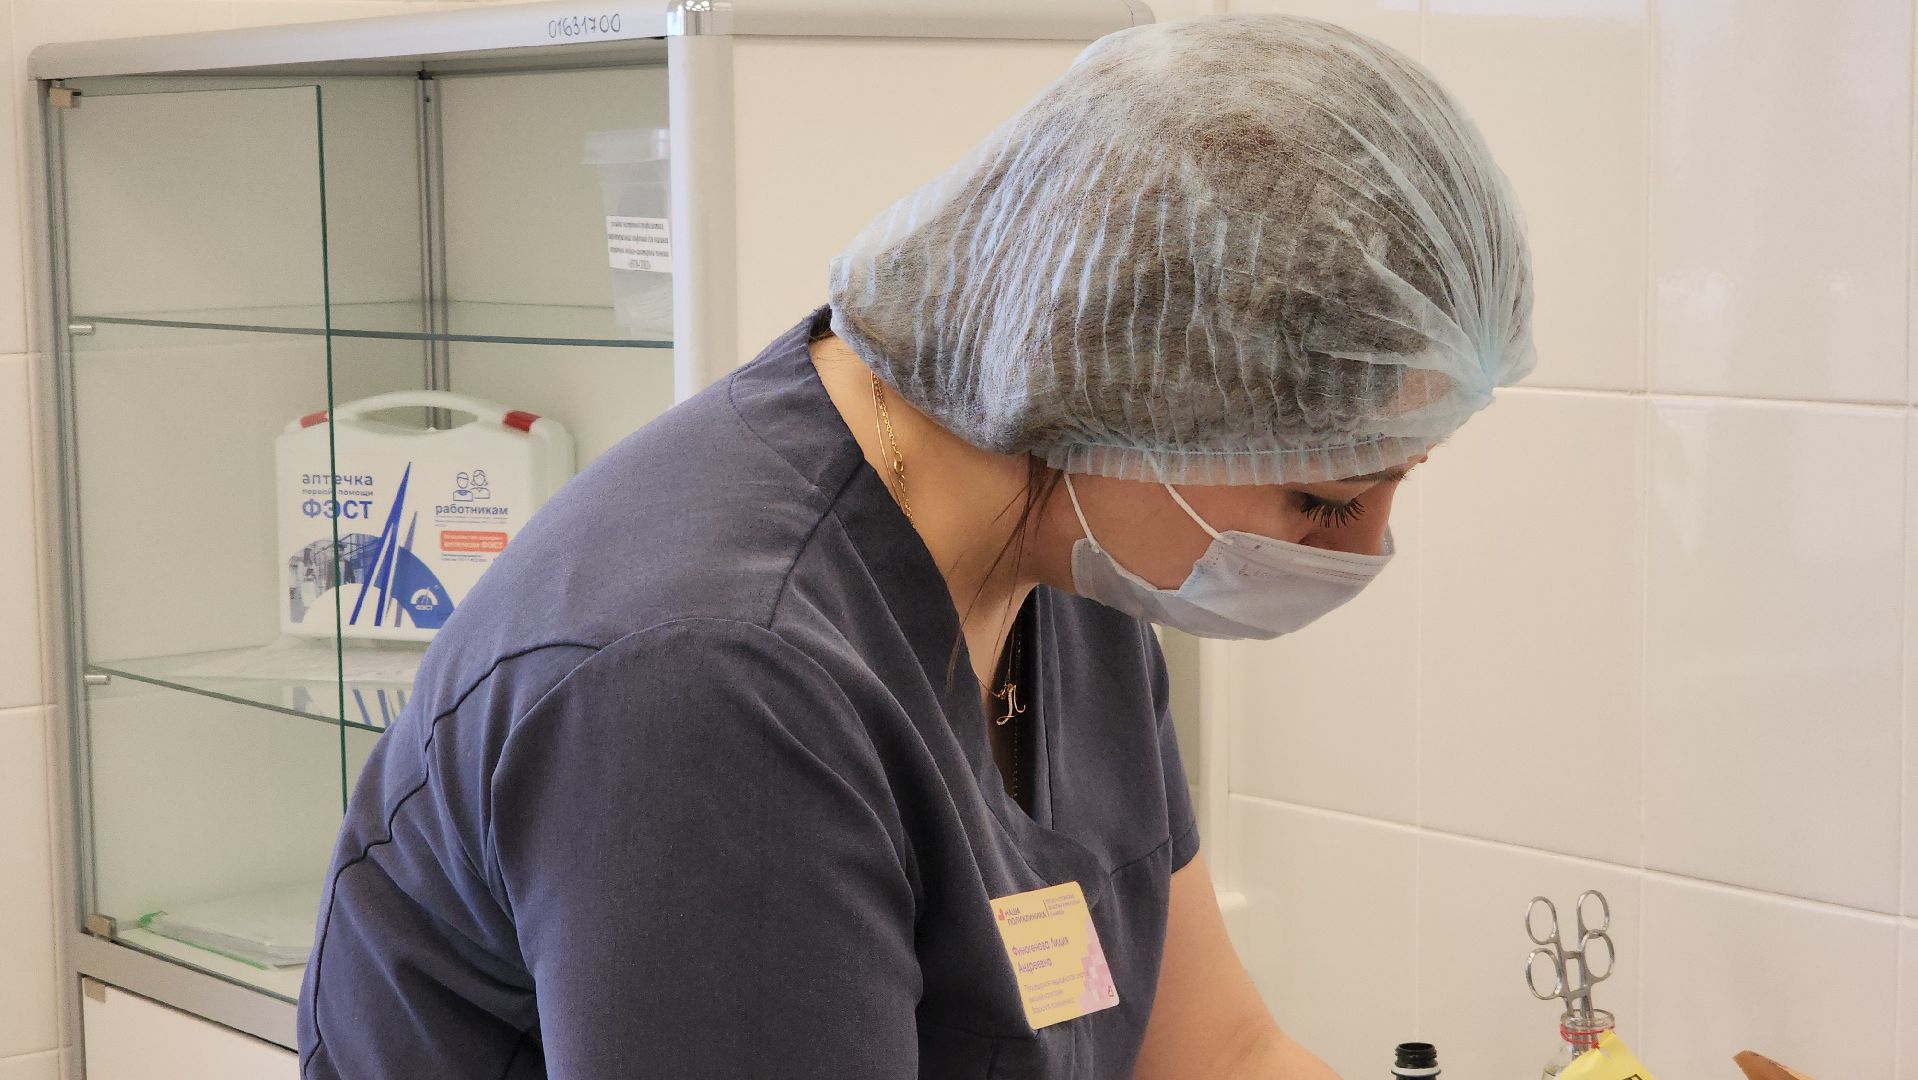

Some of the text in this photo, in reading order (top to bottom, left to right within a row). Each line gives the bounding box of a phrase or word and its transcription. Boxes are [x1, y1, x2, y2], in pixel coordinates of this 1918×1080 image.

[548, 13, 621, 38] 01631700
[302, 474, 373, 486] аптечка
[302, 498, 373, 520] ФЭСТ
[435, 503, 508, 516] работникам
